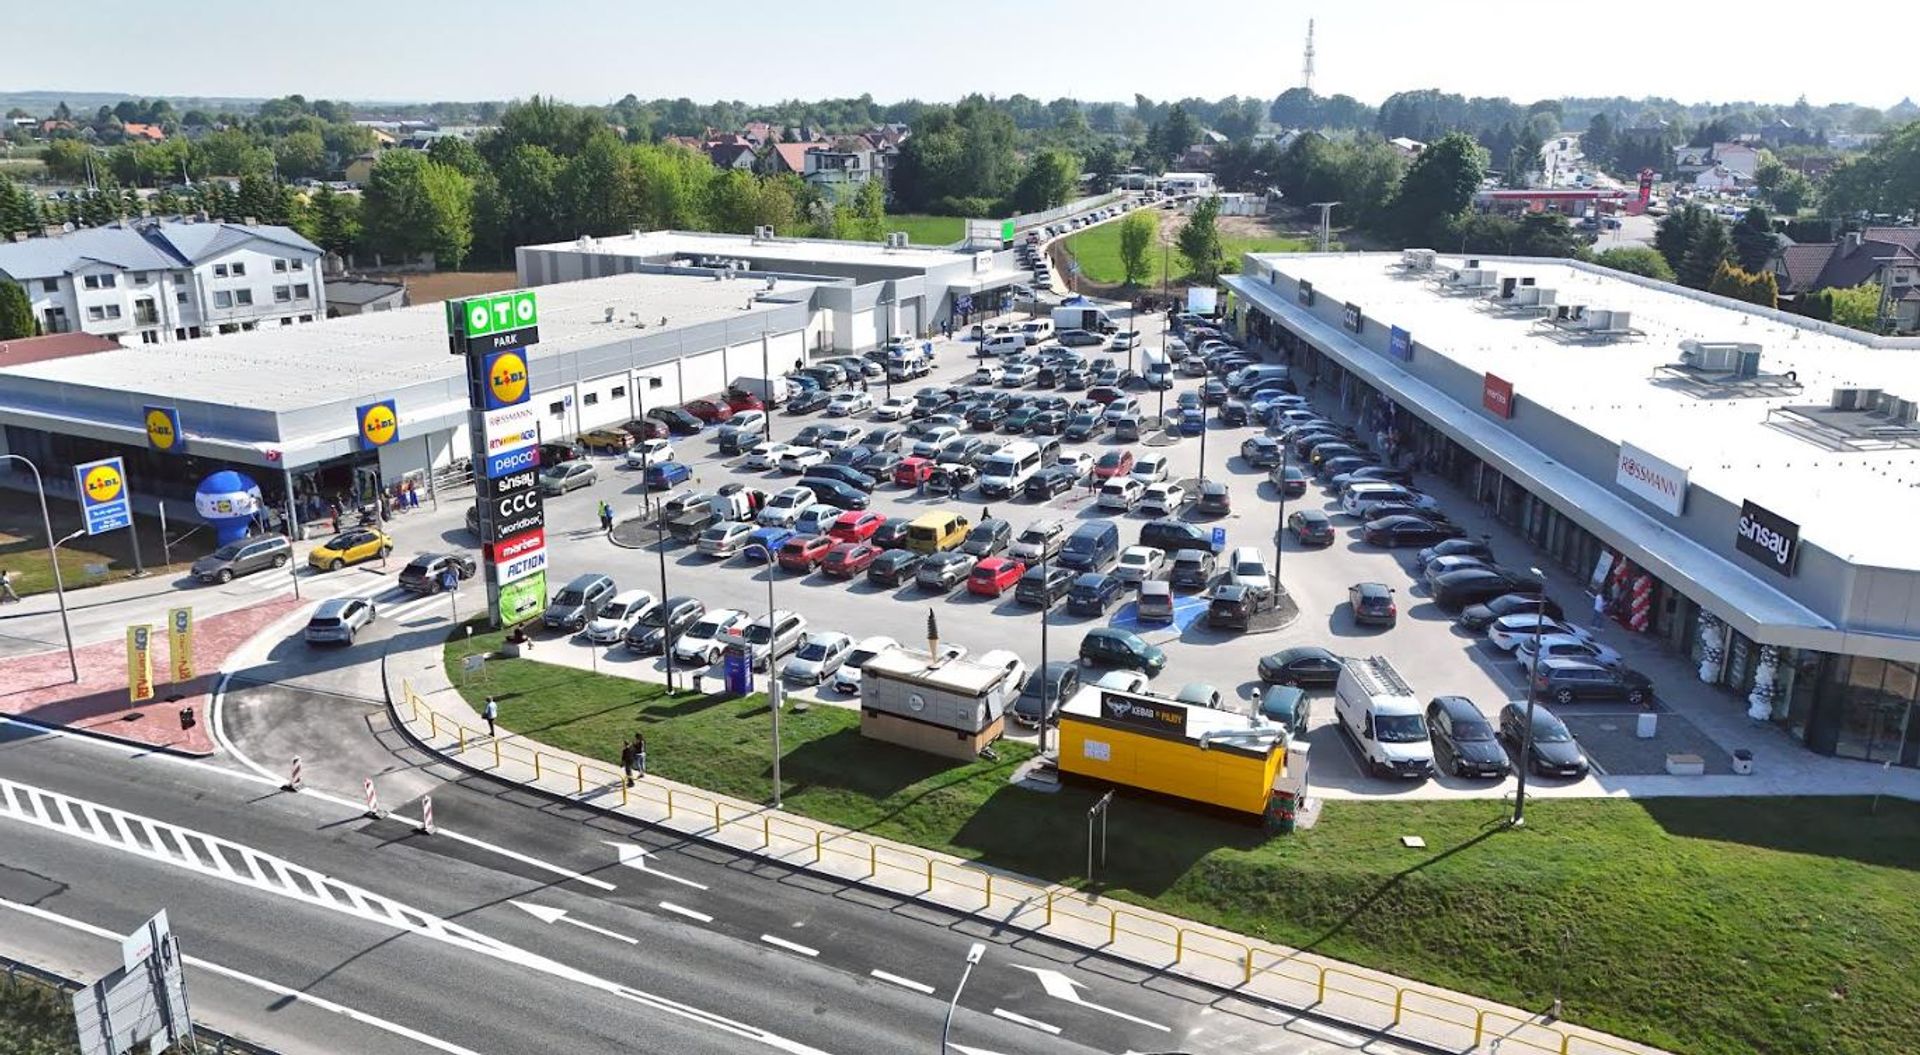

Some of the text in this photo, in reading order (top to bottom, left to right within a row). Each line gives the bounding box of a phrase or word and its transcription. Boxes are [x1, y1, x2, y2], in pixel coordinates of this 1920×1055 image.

[471, 297, 534, 329] OTO
[493, 334, 518, 348] PARK
[495, 450, 534, 473] pepco
[498, 471, 535, 492] sinsay
[1621, 455, 1678, 498] ROSSMANN
[500, 490, 537, 517] CCC
[1738, 514, 1791, 565] sinsay
[507, 555, 545, 578] ACTION
[137, 679, 149, 698] RTV
[1131, 706, 1154, 718] KEBAB
